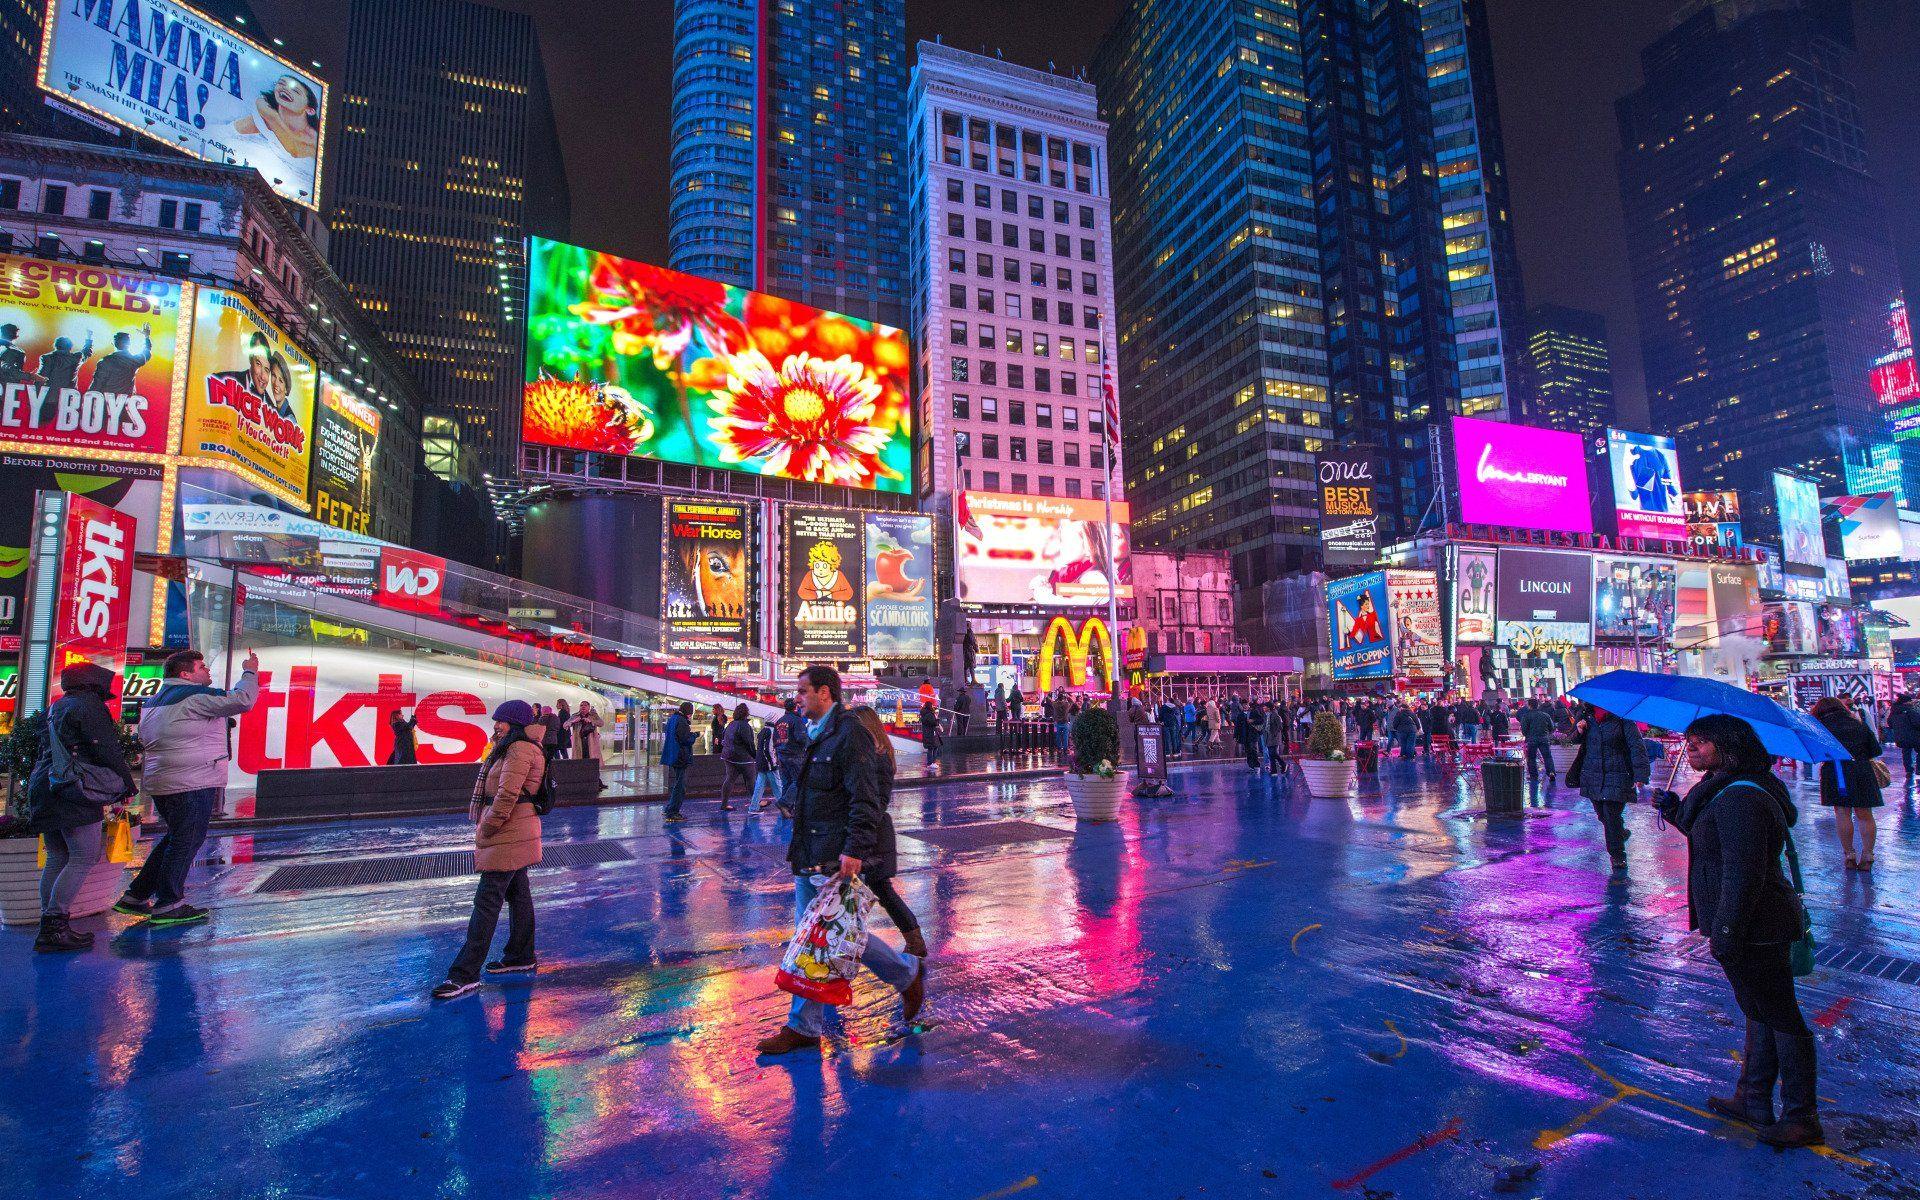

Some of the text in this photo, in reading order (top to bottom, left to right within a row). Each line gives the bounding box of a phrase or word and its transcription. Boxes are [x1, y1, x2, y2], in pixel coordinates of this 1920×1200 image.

[71, 0, 244, 101] MAMMA
[105, 40, 210, 130] MIA!
[63, 71, 235, 156] THE SMASH HIT MUSICAL ABBA
[20, 261, 169, 297] CROWD
[18, 300, 39, 308] New
[42, 302, 62, 311] York
[64, 306, 90, 314] Times
[210, 293, 278, 344] Matthew BRODERICK
[56, 388, 149, 438] BOYS
[207, 374, 262, 425] NICE
[261, 402, 305, 454] WORK
[340, 392, 375, 427] WINNER!
[340, 407, 355, 424] TONY
[45, 435, 72, 443] West
[103, 441, 135, 449] Street
[237, 415, 245, 431] If
[245, 421, 258, 440] You
[258, 429, 271, 446] Can
[271, 440, 283, 456] Get
[320, 426, 360, 456] EXHILARATING
[341, 428, 357, 444] MOST
[319, 446, 359, 475] STORYTELLING
[324, 439, 357, 463] BROADWAY
[200, 442, 252, 468] BROADWAY'S
[252, 461, 275, 479] FUNNIEST
[275, 475, 288, 488] LOVE
[288, 483, 302, 495] STORY
[320, 459, 328, 470] IN
[1527, 472, 1568, 487] BRYANT
[966, 494, 1022, 513] Christmas
[1036, 500, 1074, 517] Worship
[1324, 487, 1370, 502] BEST
[1325, 501, 1372, 510] MUSICAL
[316, 489, 370, 536] PETER
[1621, 512, 1657, 523] LIVE WITHOUT
[1684, 500, 1734, 516] LIVE
[672, 523, 742, 540] War Horse
[77, 519, 124, 639] tkts
[1520, 580, 1571, 594] LINCOLN
[1716, 573, 1742, 586] Surface
[794, 600, 857, 622] Annie
[870, 610, 930, 627] SCANDALOUS
[1334, 654, 1356, 668] MARY
[1356, 645, 1391, 663] POPPINS
[237, 664, 489, 775] tkts
